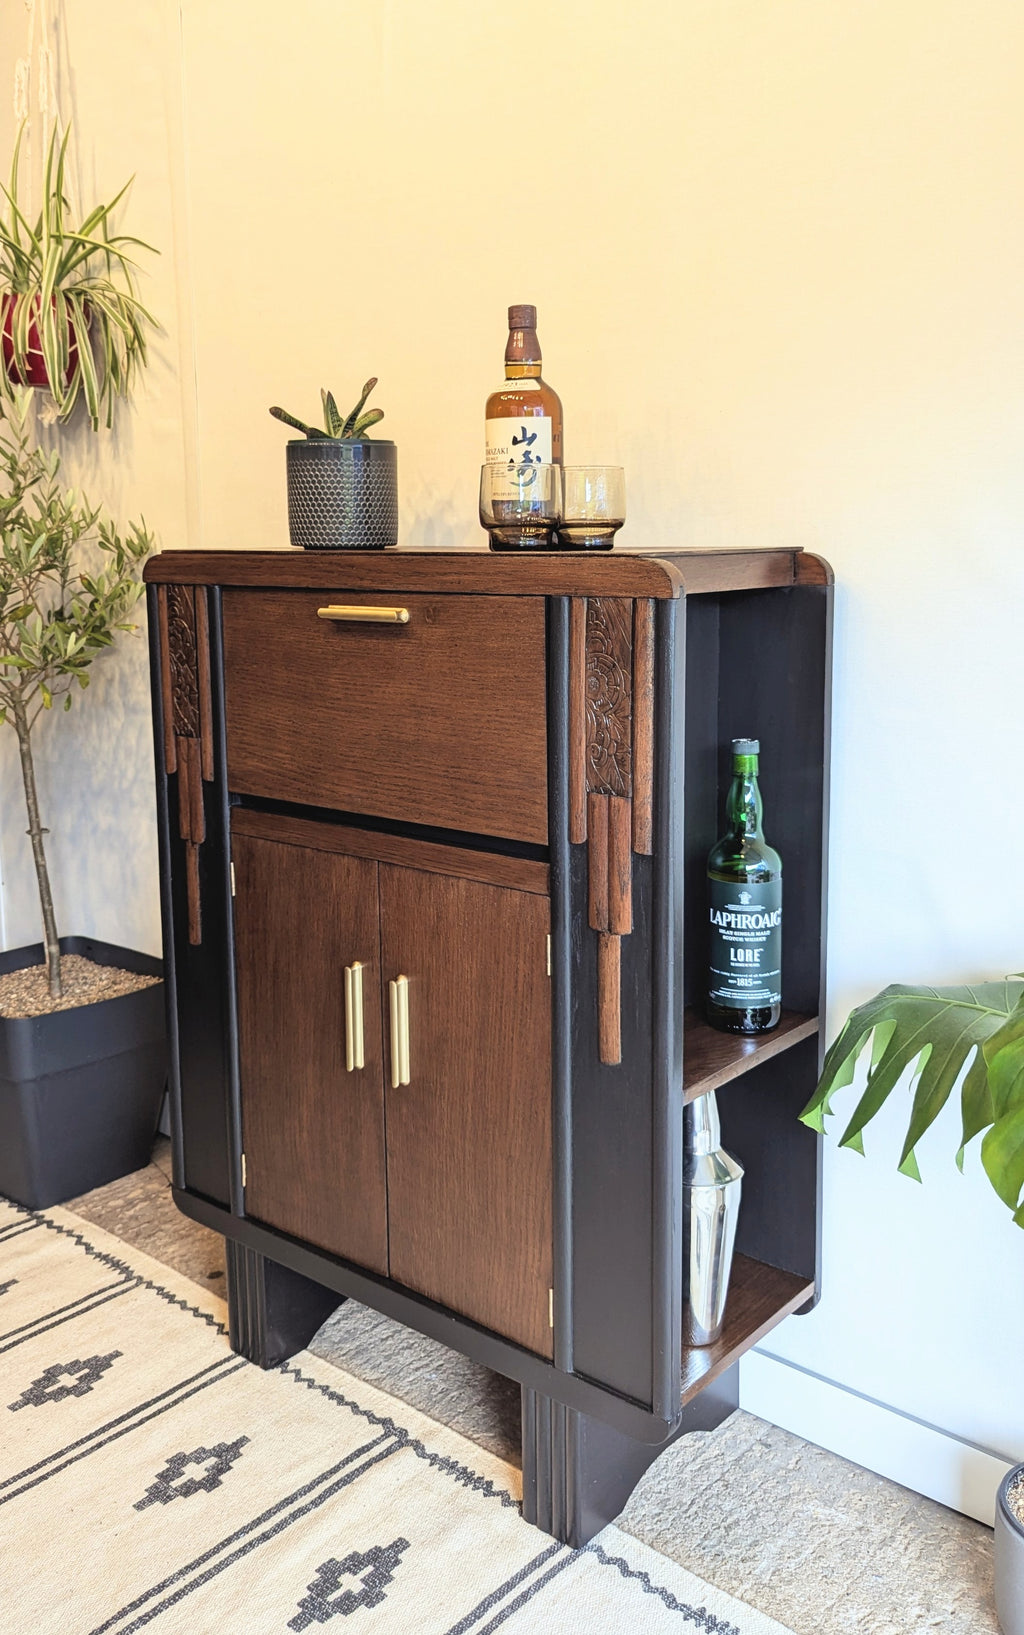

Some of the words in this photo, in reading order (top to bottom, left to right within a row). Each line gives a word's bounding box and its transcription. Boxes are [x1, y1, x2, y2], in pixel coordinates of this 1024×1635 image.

[709, 908, 782, 929] LAPHROAIG
[730, 947, 761, 962] LORE
[736, 977, 753, 987] 1815
